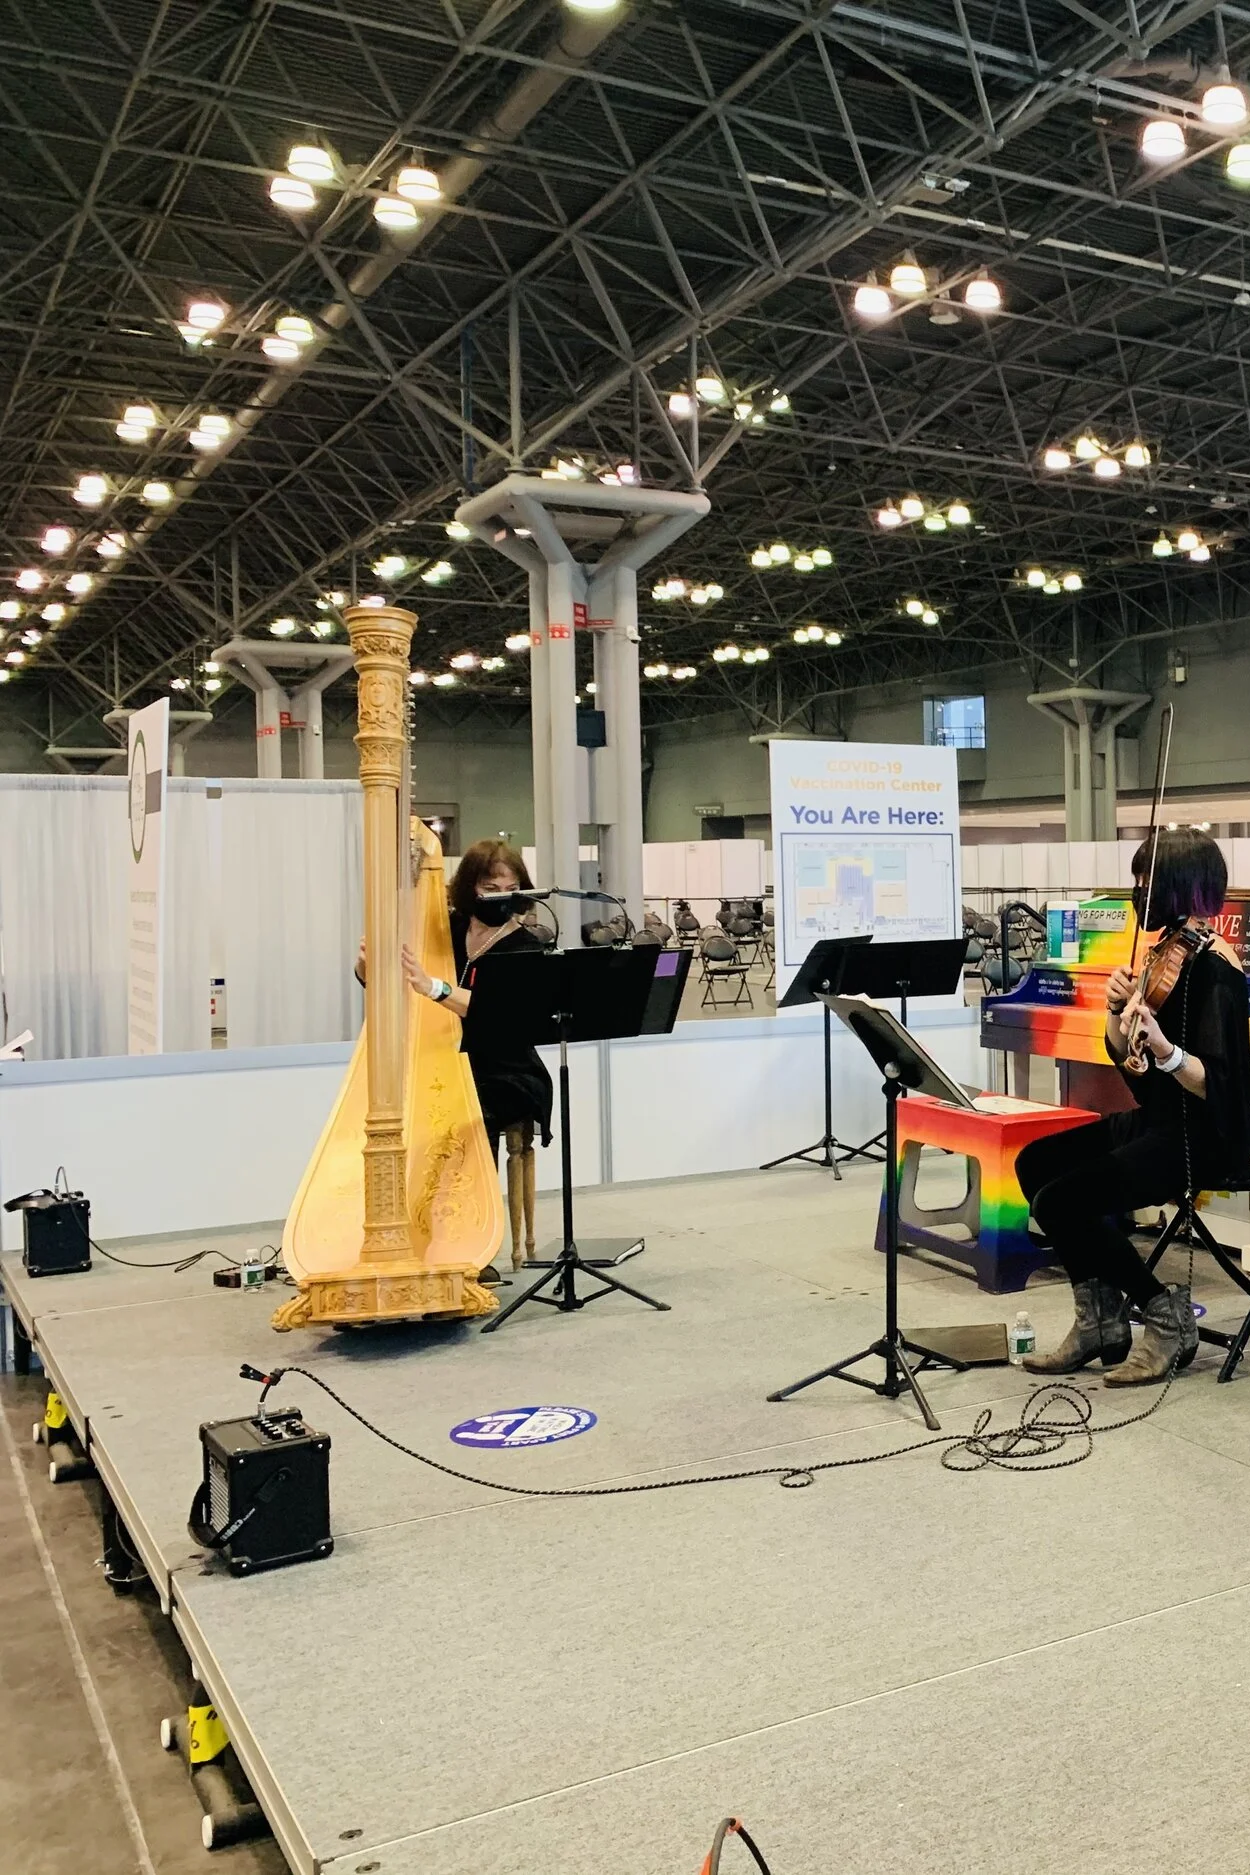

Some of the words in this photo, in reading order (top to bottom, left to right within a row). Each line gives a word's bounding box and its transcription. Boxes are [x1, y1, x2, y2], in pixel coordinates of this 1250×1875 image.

[827, 760, 903, 774] COVID-19
[790, 776, 885, 791] Vaccination
[890, 778, 942, 792] Center
[790, 806, 833, 825] You
[841, 806, 880, 825] Are
[888, 807, 944, 825] Here:
[1079, 910, 1088, 919] NG
[1106, 911, 1127, 920] HOPE
